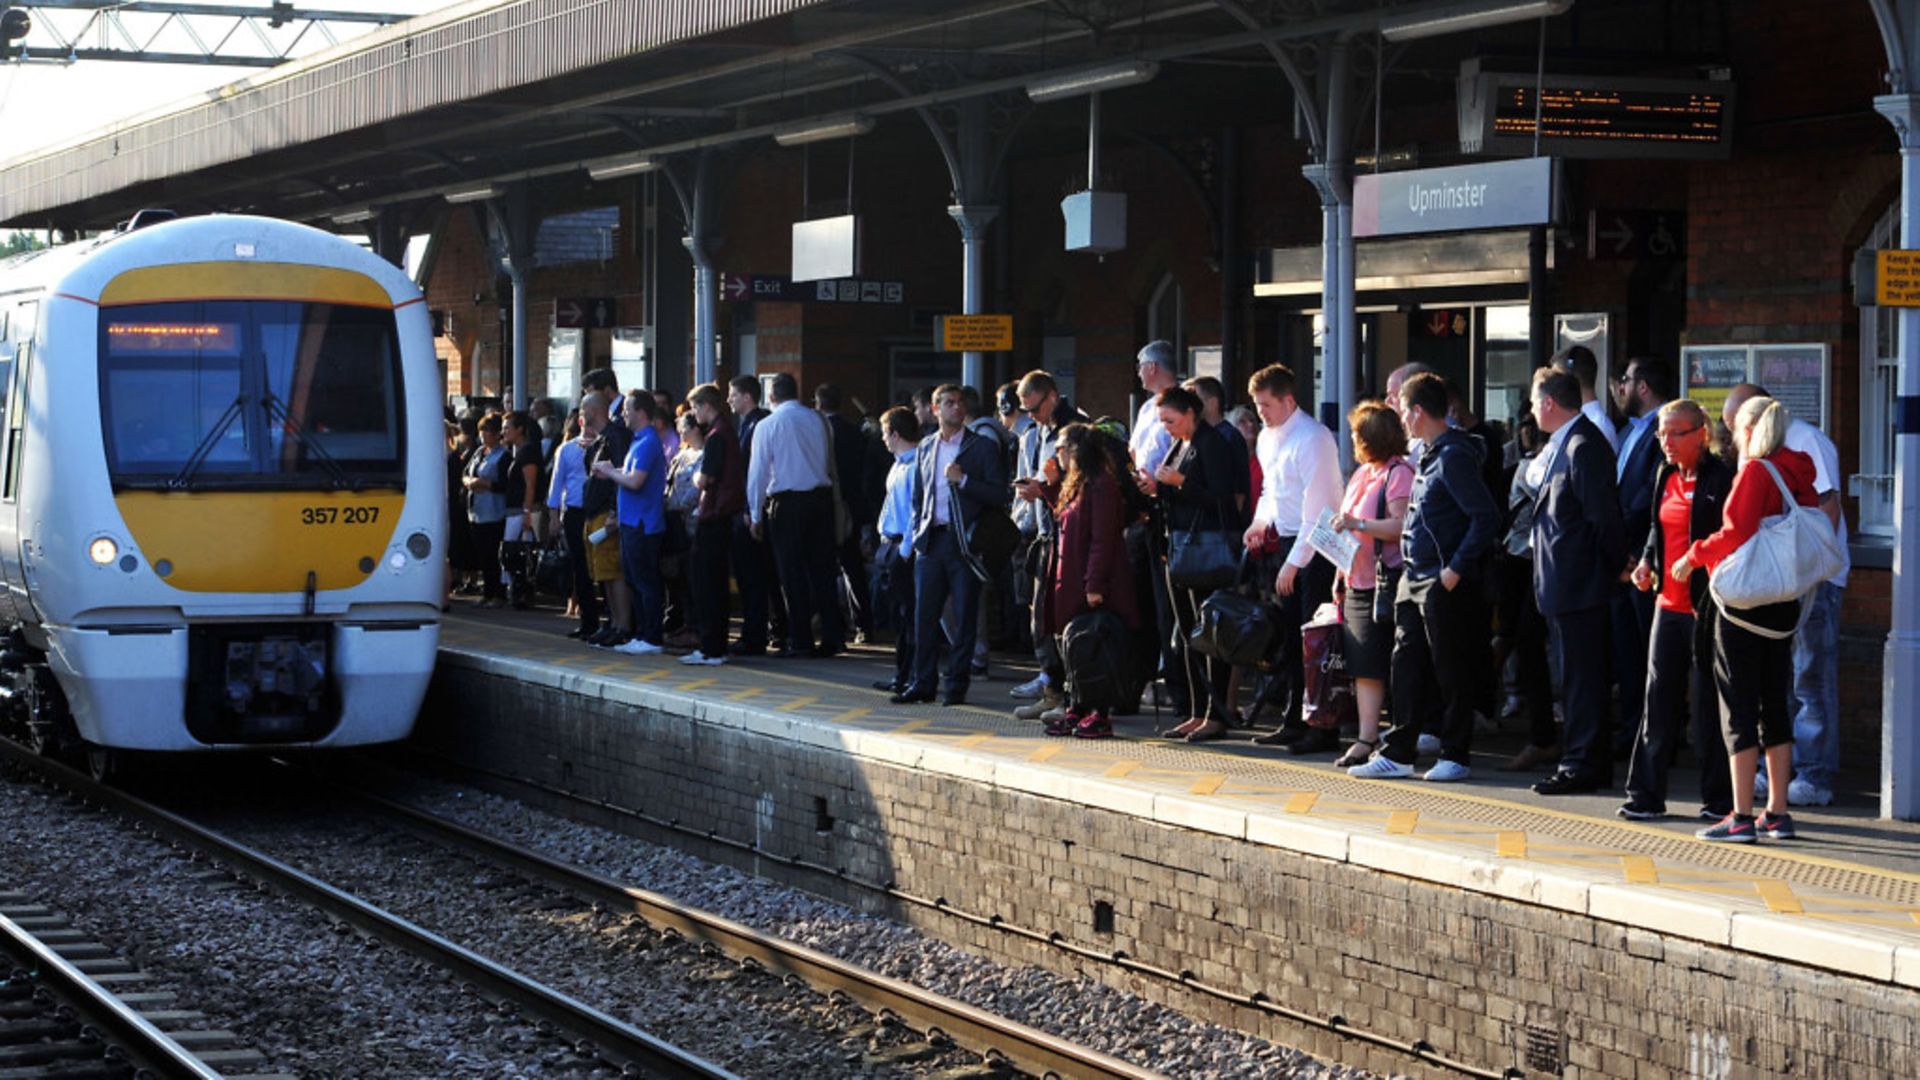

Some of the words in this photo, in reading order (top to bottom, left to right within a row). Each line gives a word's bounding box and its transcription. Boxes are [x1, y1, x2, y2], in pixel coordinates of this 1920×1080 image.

[1408, 181, 1488, 216] Upminster
[754, 280, 781, 294] Exit
[302, 507, 338, 524] 357
[343, 507, 379, 524] 207
